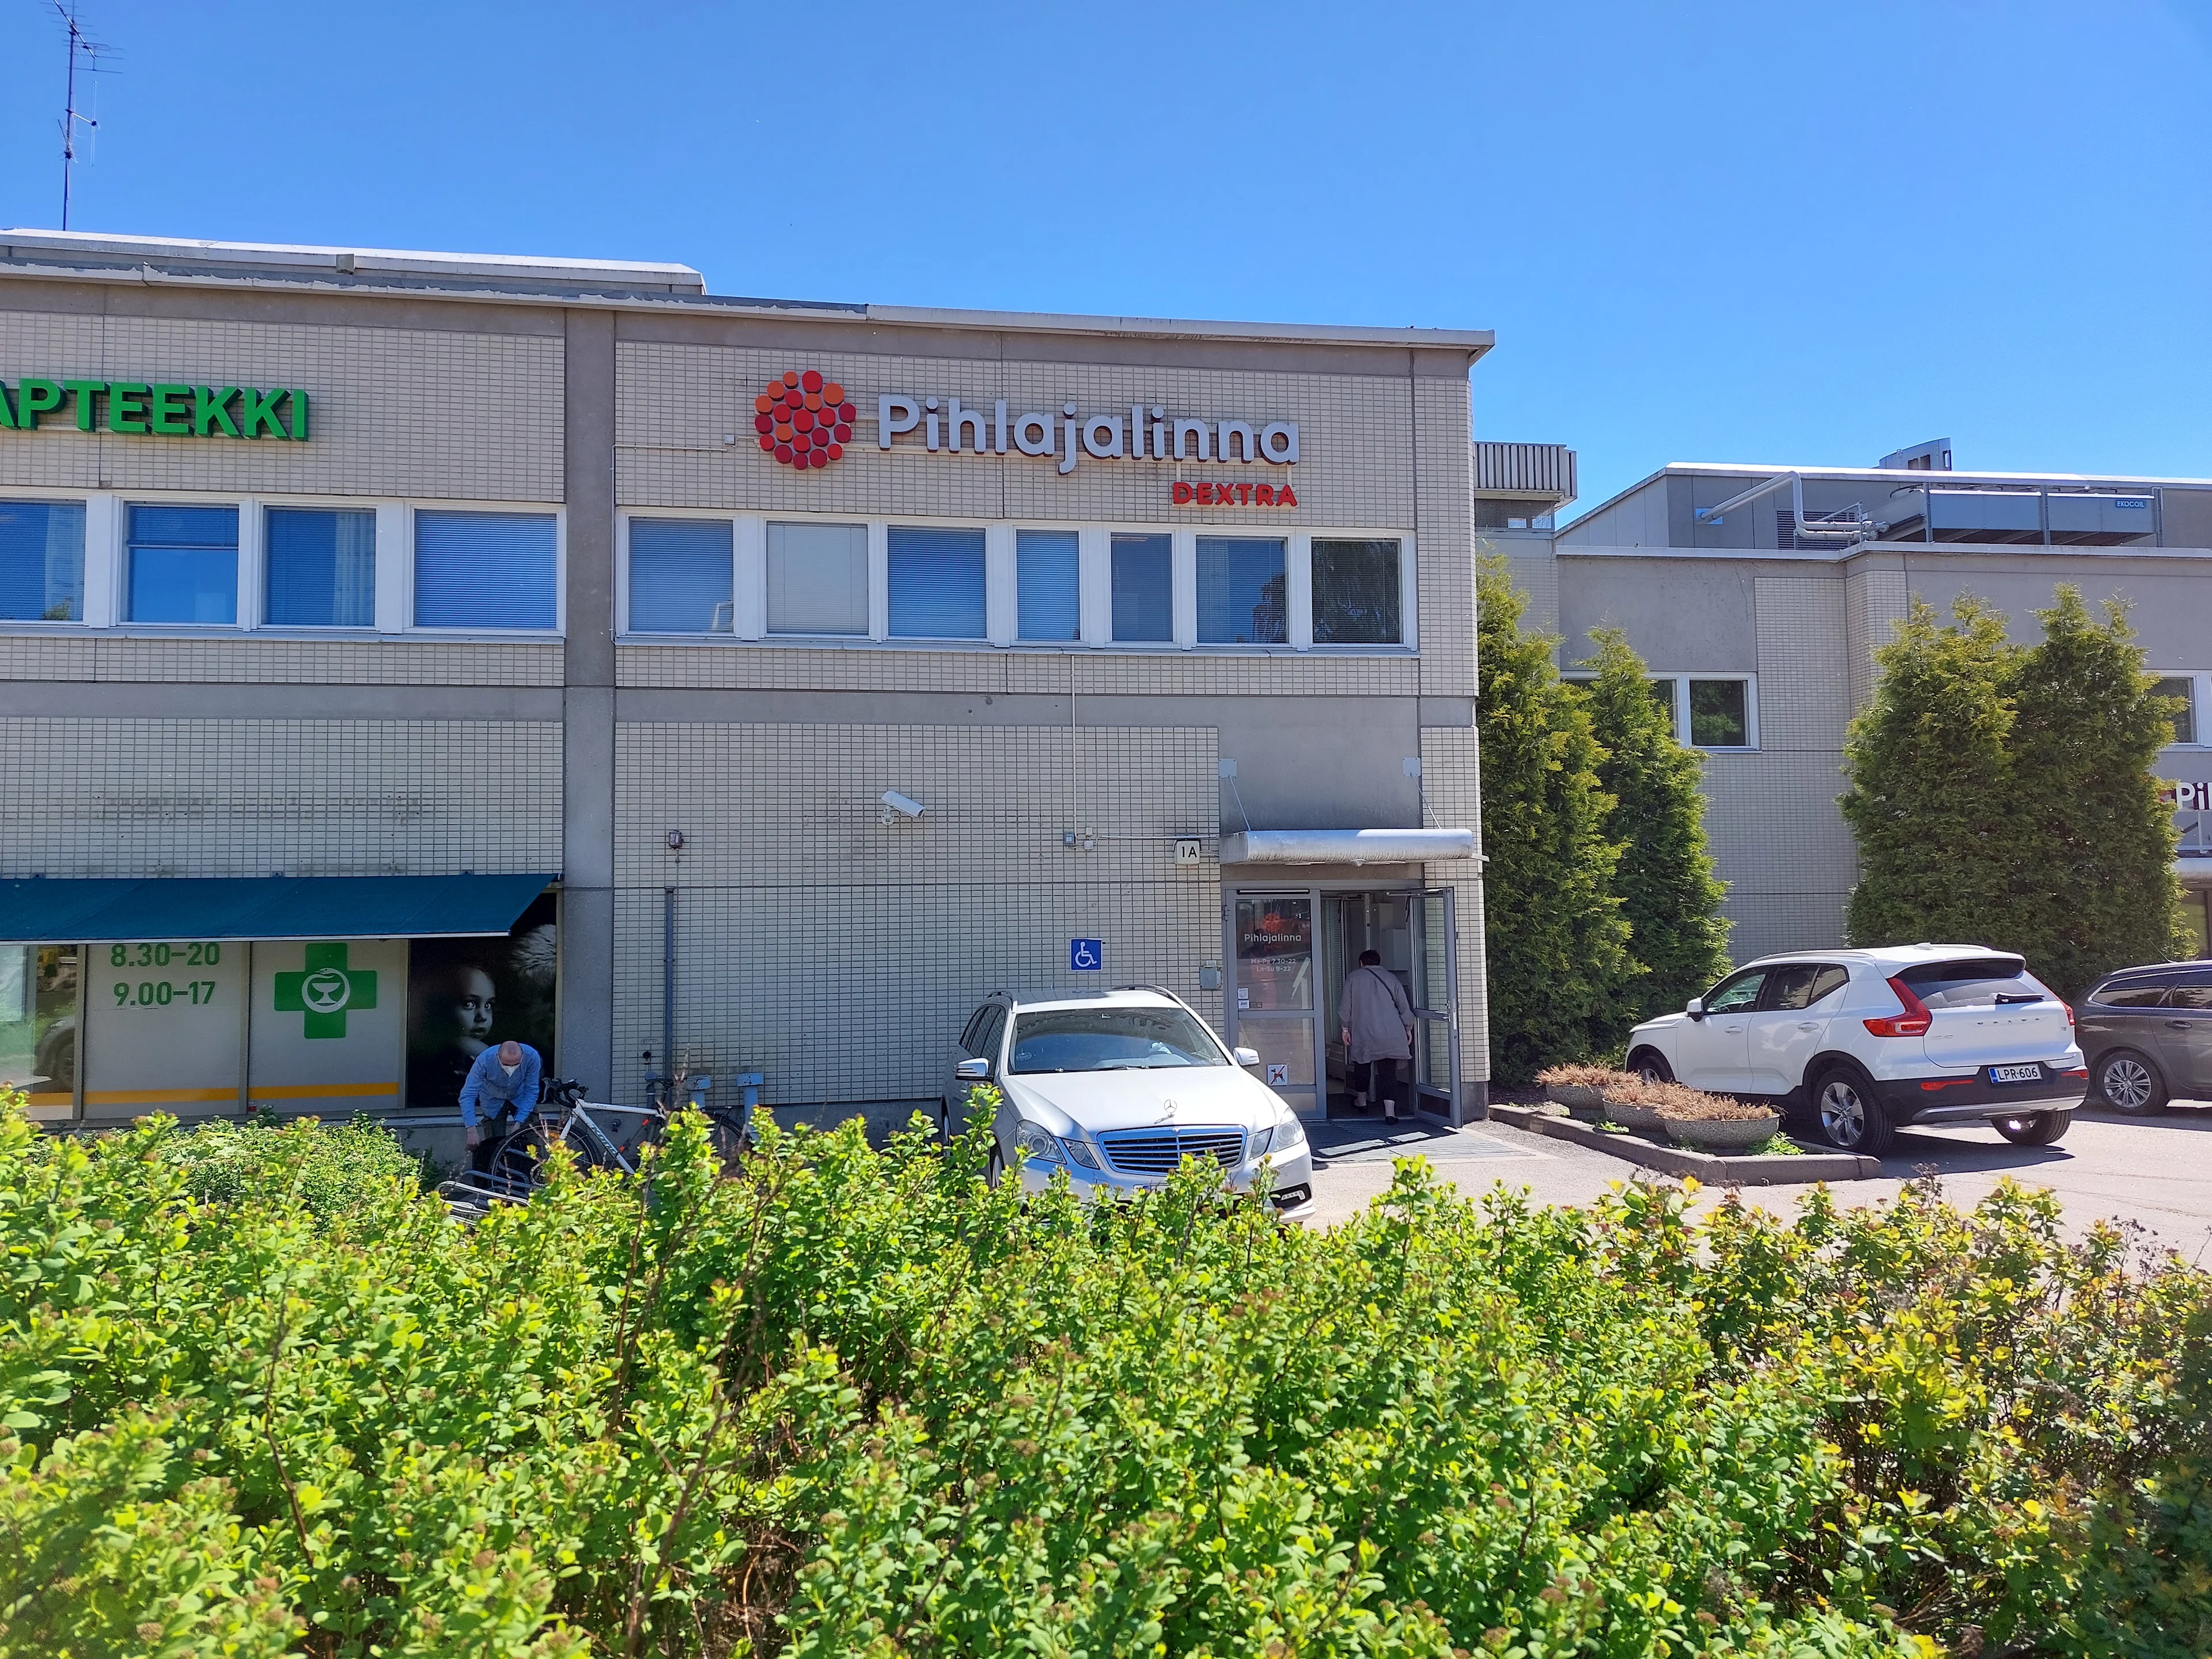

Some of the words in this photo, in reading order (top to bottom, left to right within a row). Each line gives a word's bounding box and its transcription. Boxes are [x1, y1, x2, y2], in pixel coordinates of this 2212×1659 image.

[878, 395, 1300, 475] Pihlajalinna
[1173, 482, 1298, 506] DEXTRA
[1181, 846, 1197, 858] 1A
[1244, 934, 1301, 944] Pihlajalinna
[1997, 1067, 2038, 1080] LPR-606
